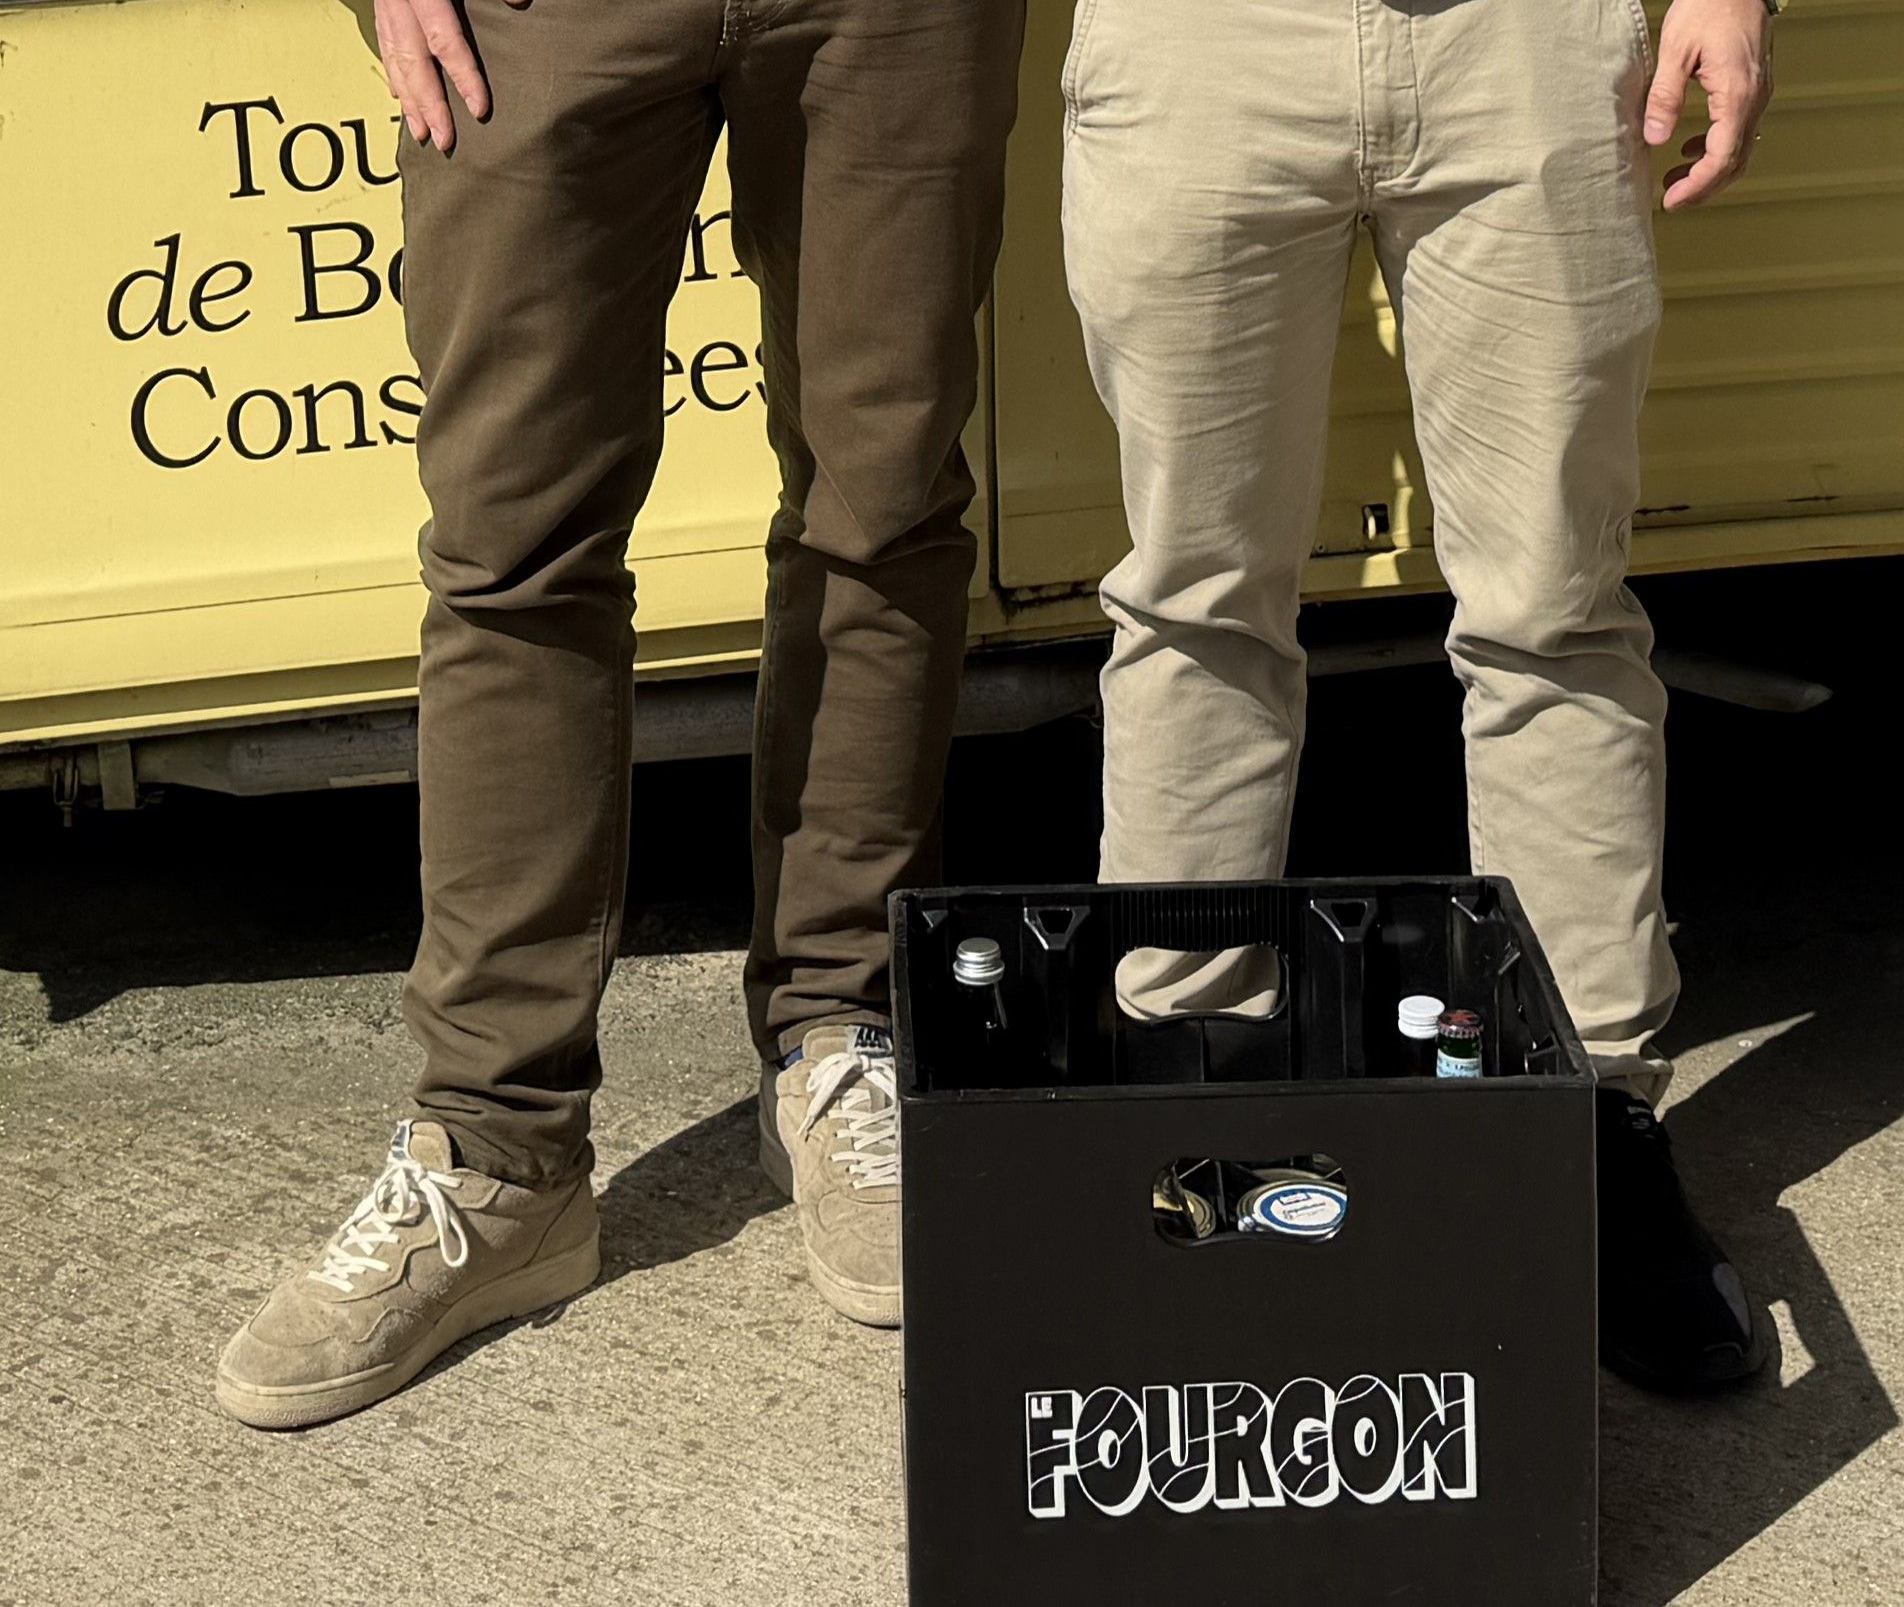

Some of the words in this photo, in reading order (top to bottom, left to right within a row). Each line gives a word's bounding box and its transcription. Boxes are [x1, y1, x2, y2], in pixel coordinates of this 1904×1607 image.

[198, 95, 401, 199] Tou
[107, 233, 254, 342] de
[1025, 1372, 1477, 1519] FOURGON
[1030, 1396, 1053, 1419] LE
